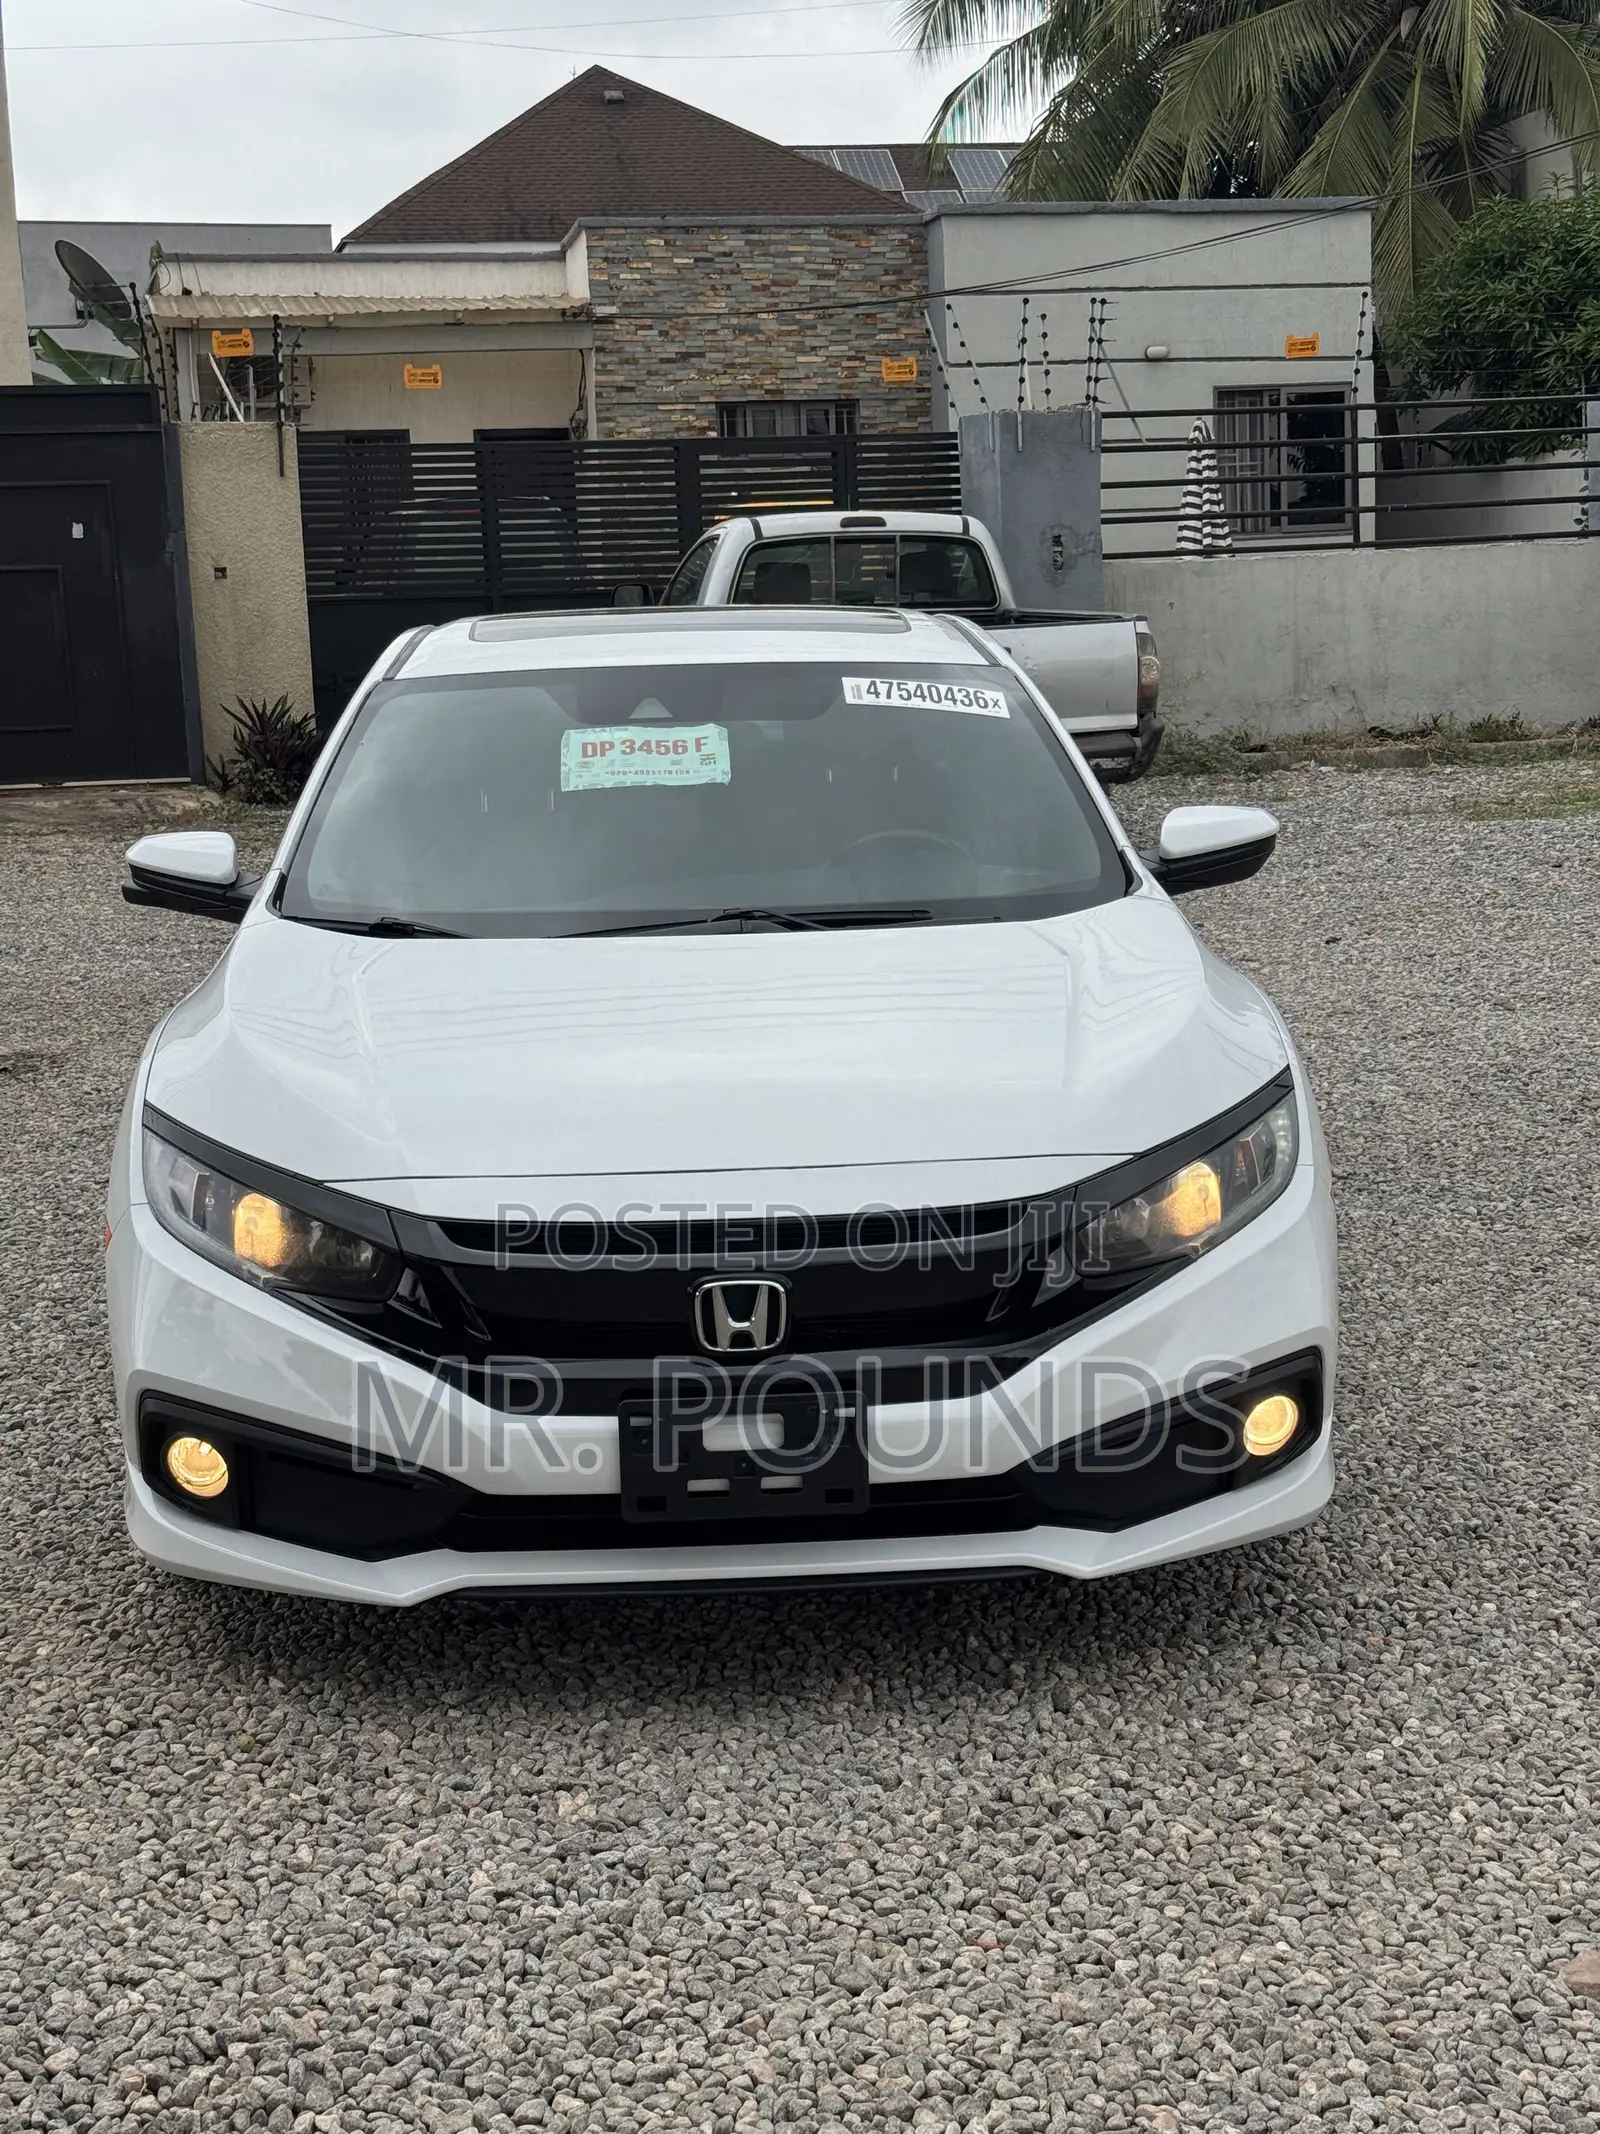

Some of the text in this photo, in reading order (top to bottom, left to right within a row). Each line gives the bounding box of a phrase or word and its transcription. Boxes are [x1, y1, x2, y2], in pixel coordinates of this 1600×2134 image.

[581, 736, 709, 758] DP 3456 F
